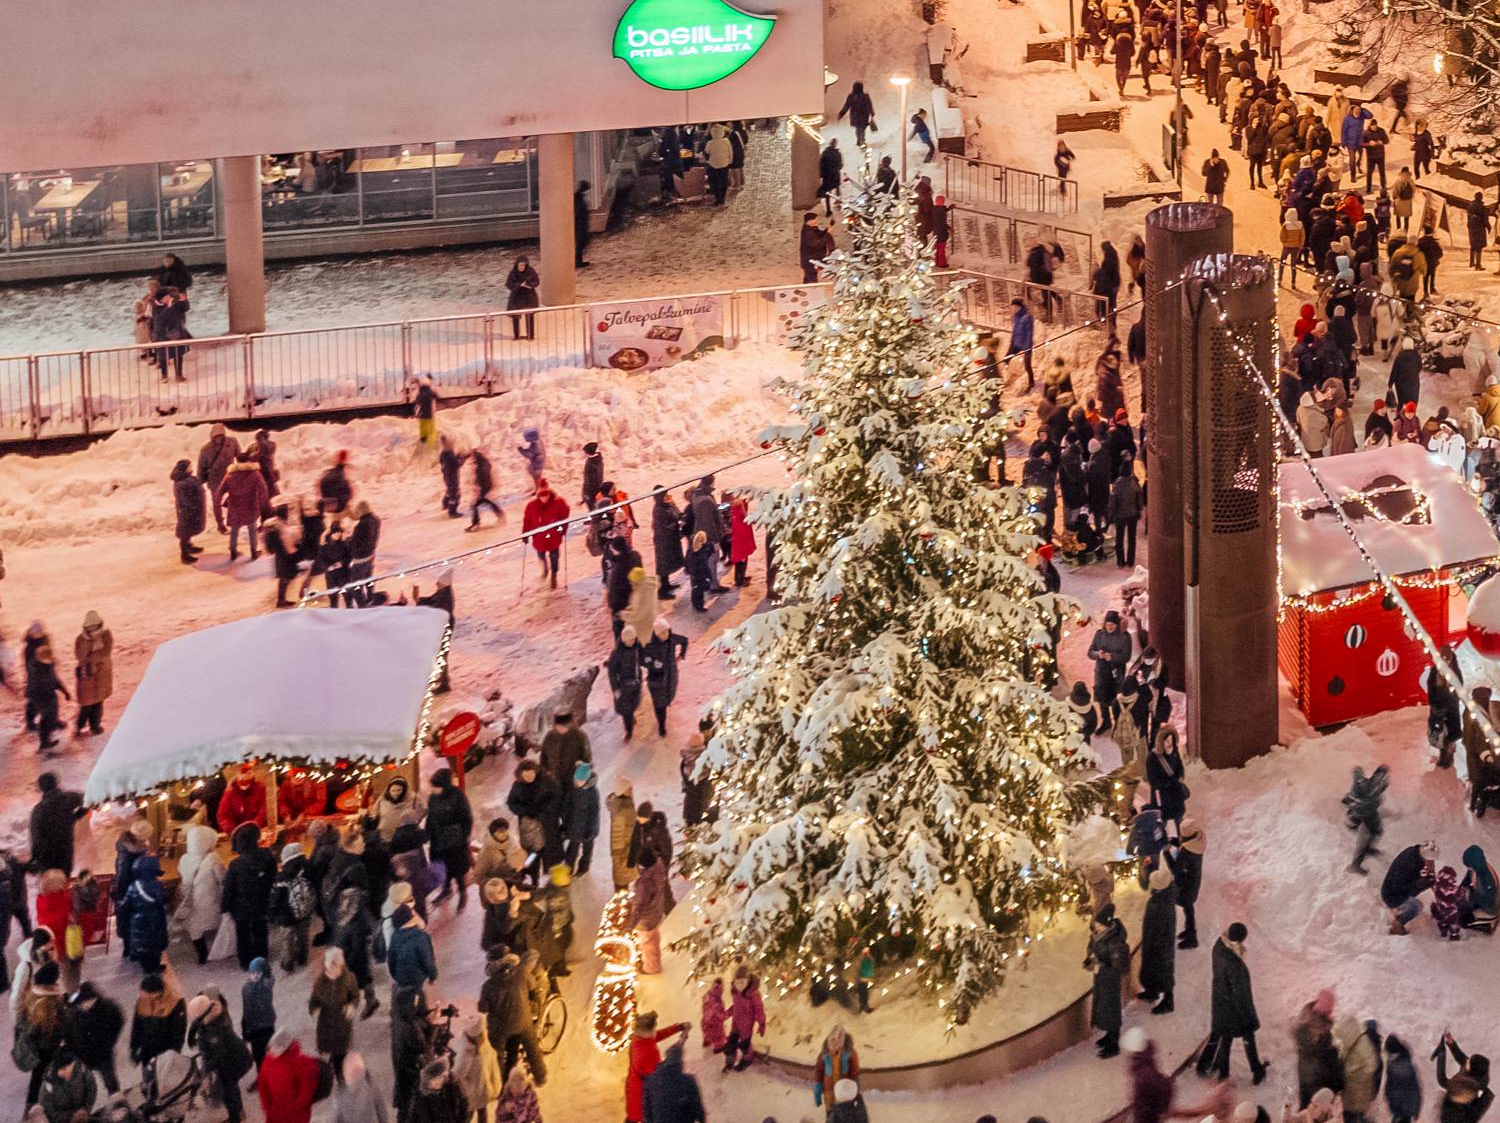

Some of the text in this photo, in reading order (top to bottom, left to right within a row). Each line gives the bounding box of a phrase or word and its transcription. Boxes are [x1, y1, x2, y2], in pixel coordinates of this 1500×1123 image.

[630, 42, 751, 59] PITSA JA PASTA
[605, 303, 713, 327] Talvepakkumine
